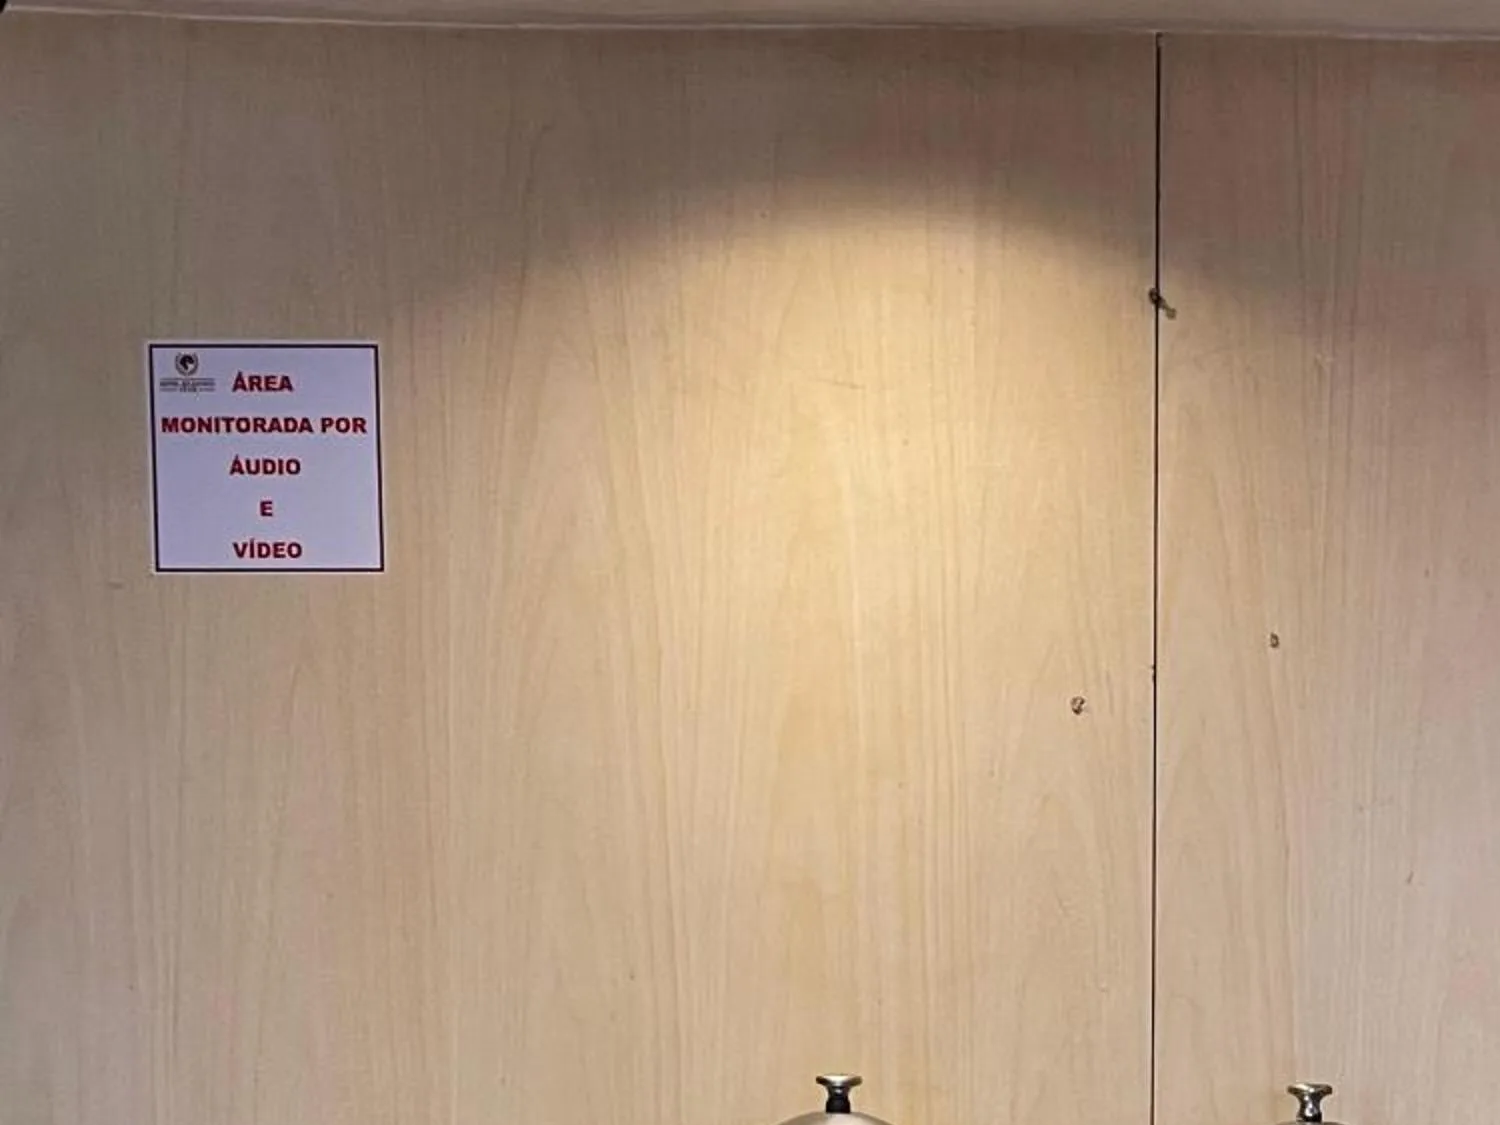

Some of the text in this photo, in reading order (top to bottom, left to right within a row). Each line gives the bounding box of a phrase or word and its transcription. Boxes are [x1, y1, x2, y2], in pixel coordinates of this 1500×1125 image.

[232, 371, 293, 392] ÁREA
[161, 417, 367, 434] MONITORADA POR
[229, 454, 301, 475] ÁUDIO
[260, 501, 273, 517] E
[232, 538, 302, 559] VÍDEO
